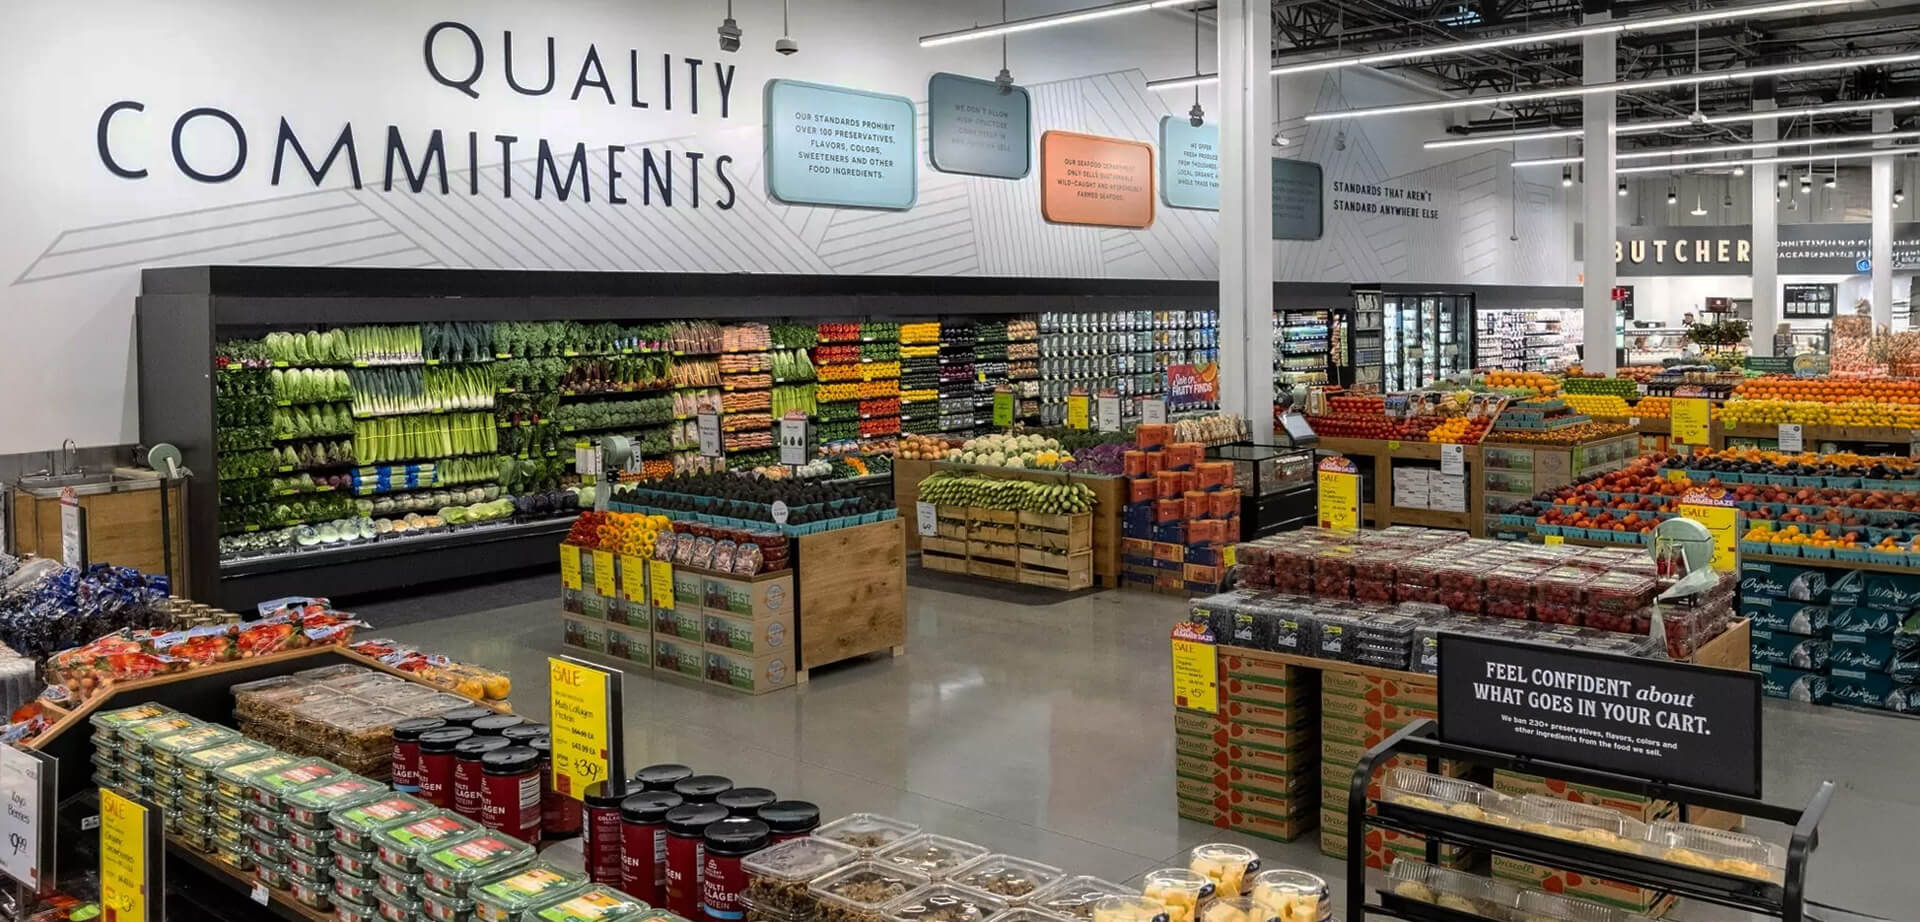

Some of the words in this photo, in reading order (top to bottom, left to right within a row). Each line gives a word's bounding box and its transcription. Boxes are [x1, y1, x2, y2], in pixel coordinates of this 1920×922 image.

[424, 21, 735, 118] QUALITY
[795, 112, 811, 120] OUR
[814, 114, 860, 127] STANDARDS
[862, 120, 895, 131] PROHIBIT
[795, 125, 816, 134] OVER
[819, 127, 832, 136] 100
[834, 129, 896, 144] PRESERVATIVES,
[97, 101, 736, 210] COMMITMENTS
[810, 139, 848, 152] FLAVORS,
[850, 143, 882, 155] COLORS,
[798, 151, 849, 163] SWEETENERS
[851, 156, 868, 165] AND
[869, 158, 893, 167] OTHER
[1077, 160, 1102, 168] SEAFOOD
[808, 165, 831, 174] FOOD
[832, 167, 884, 179] INGREDIENTS.
[1057, 179, 1097, 188] WILD-CAUGHT
[1333, 181, 1381, 196] STANDARDS
[1384, 187, 1403, 198] THAT
[1406, 189, 1432, 202] AREN'T
[1333, 199, 1377, 213] STANDARD
[1379, 204, 1420, 217] ANYWHERE
[1422, 208, 1439, 219] ELSE
[553, 663, 581, 687] SALE
[1486, 661, 1528, 683] FEEL
[1531, 668, 1632, 698] CONFIDENT
[1636, 685, 1696, 708] about
[1473, 682, 1524, 706] WHAT
[1528, 691, 1573, 713] GOES
[1578, 698, 1596, 717] IN
[1601, 702, 1651, 726] YOUR
[1655, 710, 1711, 735] CART.
[1501, 714, 1512, 722] We
[1513, 716, 1527, 724] ban
[1529, 719, 1548, 728] 230+
[1550, 723, 1604, 738] preservatives,
[1605, 731, 1634, 743] flavors,
[1636, 737, 1661, 747] colors
[1662, 741, 1678, 750] and
[1514, 726, 1534, 735] other
[1536, 729, 1577, 743] ingredients
[1579, 736, 1597, 746] from
[1599, 740, 1612, 748] the
[1614, 742, 1631, 751] food
[1494, 854, 1535, 874] Driscoll's
